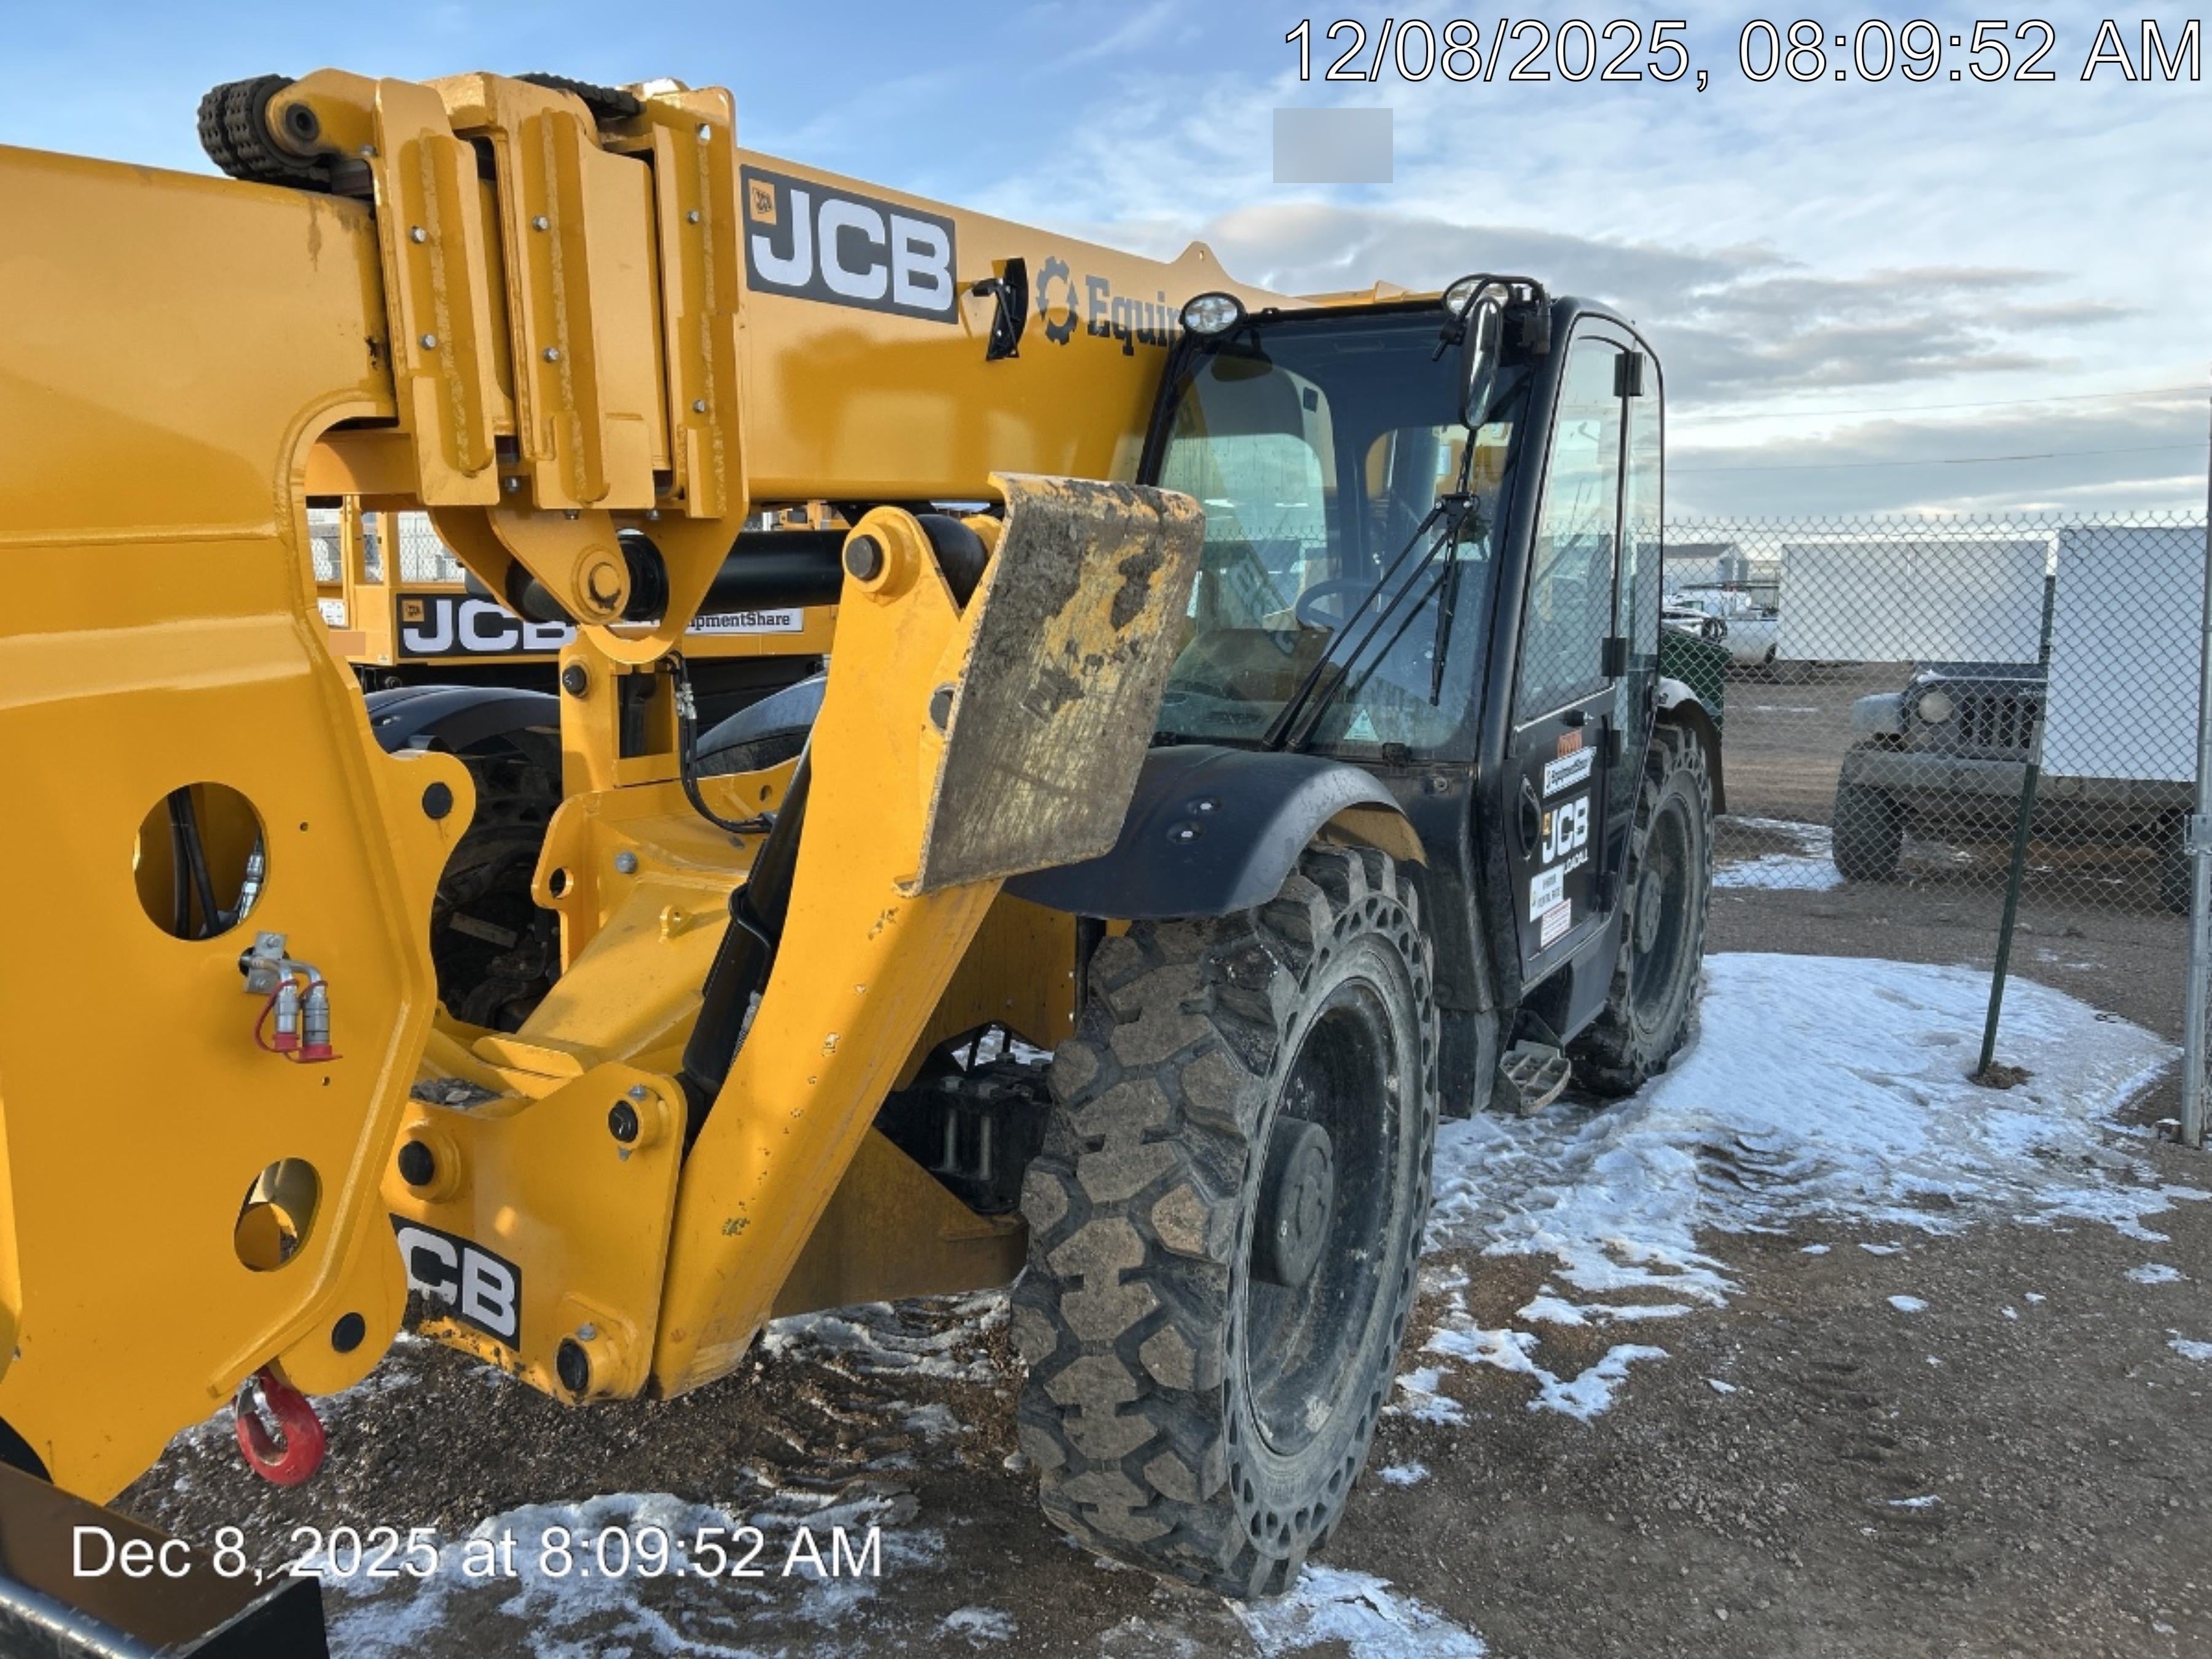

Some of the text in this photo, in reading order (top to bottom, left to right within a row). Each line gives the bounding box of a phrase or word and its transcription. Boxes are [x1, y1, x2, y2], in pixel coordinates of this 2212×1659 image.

[751, 189, 954, 311] JCB
[1542, 796, 1588, 864] JCB
[397, 1226, 516, 1338] CB
